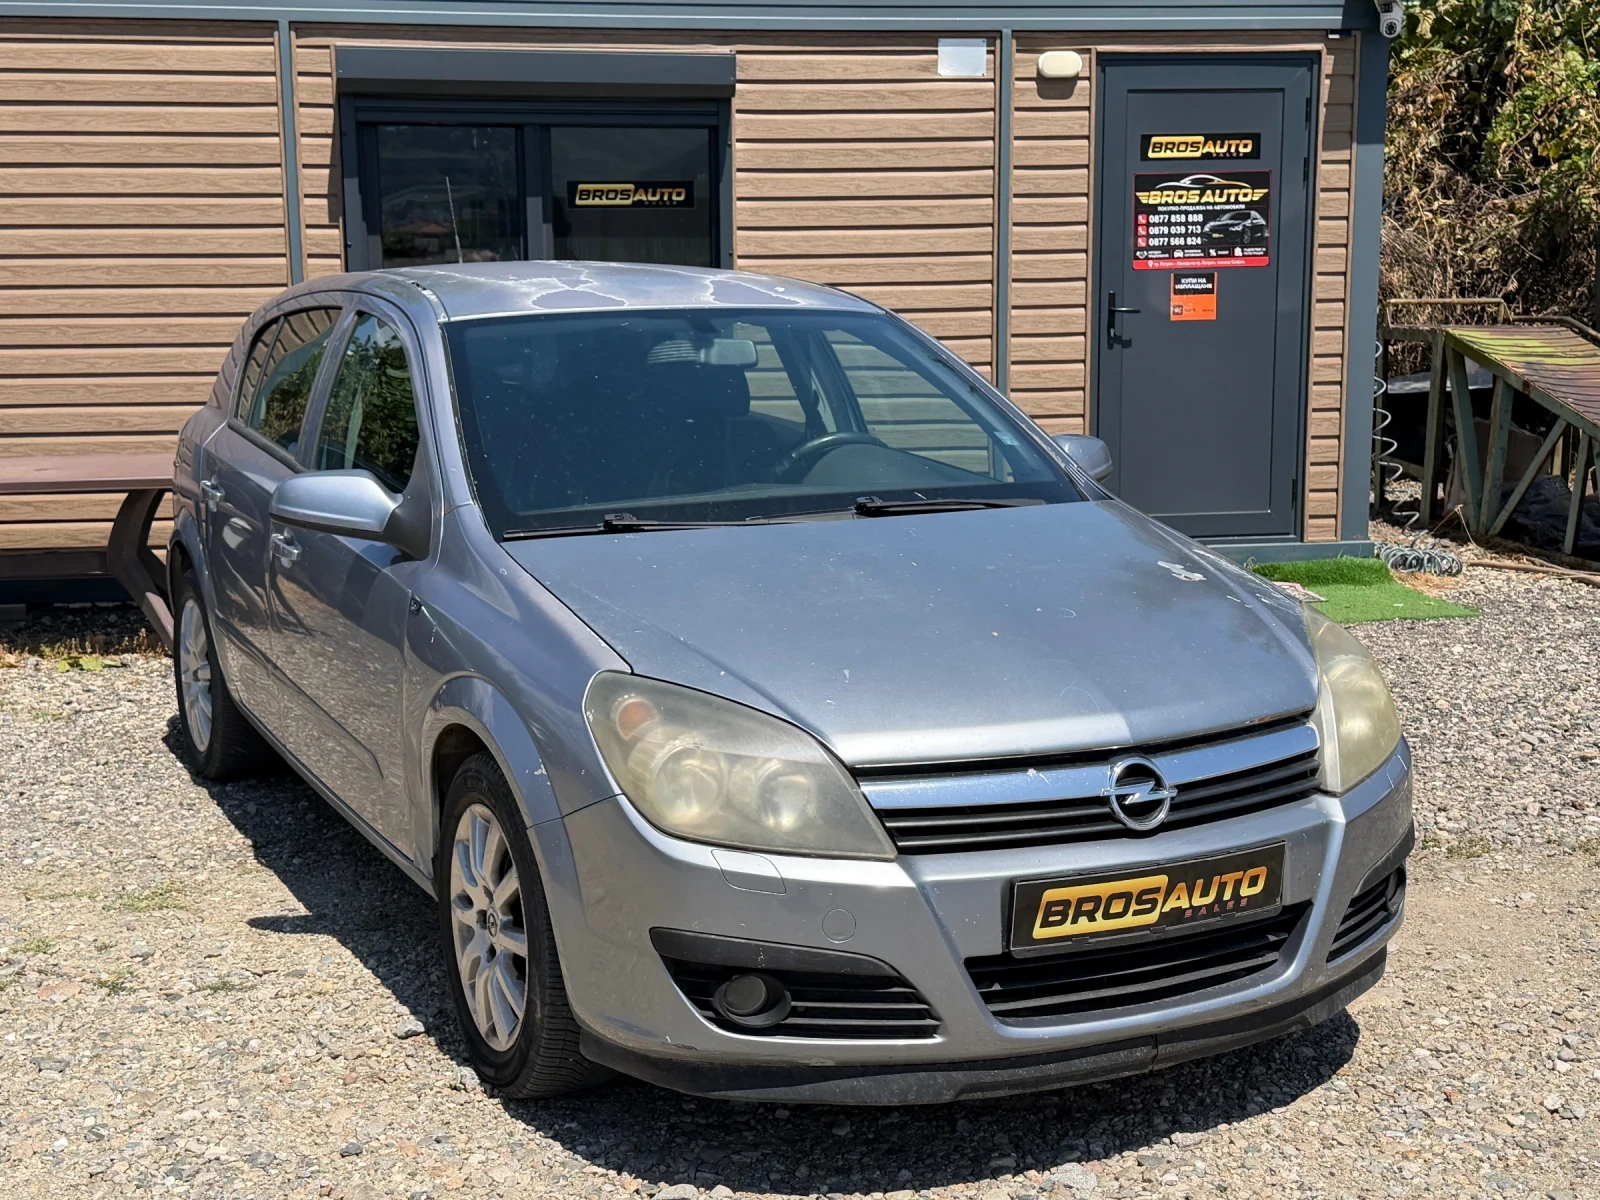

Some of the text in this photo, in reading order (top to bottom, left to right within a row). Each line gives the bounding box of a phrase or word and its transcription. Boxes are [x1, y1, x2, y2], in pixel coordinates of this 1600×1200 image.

[1149, 215, 1169, 223] 0877
[1187, 214, 1203, 222] 888
[1149, 225, 1201, 235] 0879 039 713
[1149, 236, 1202, 246] 0877 566 824
[1184, 898, 1248, 918] SALES
